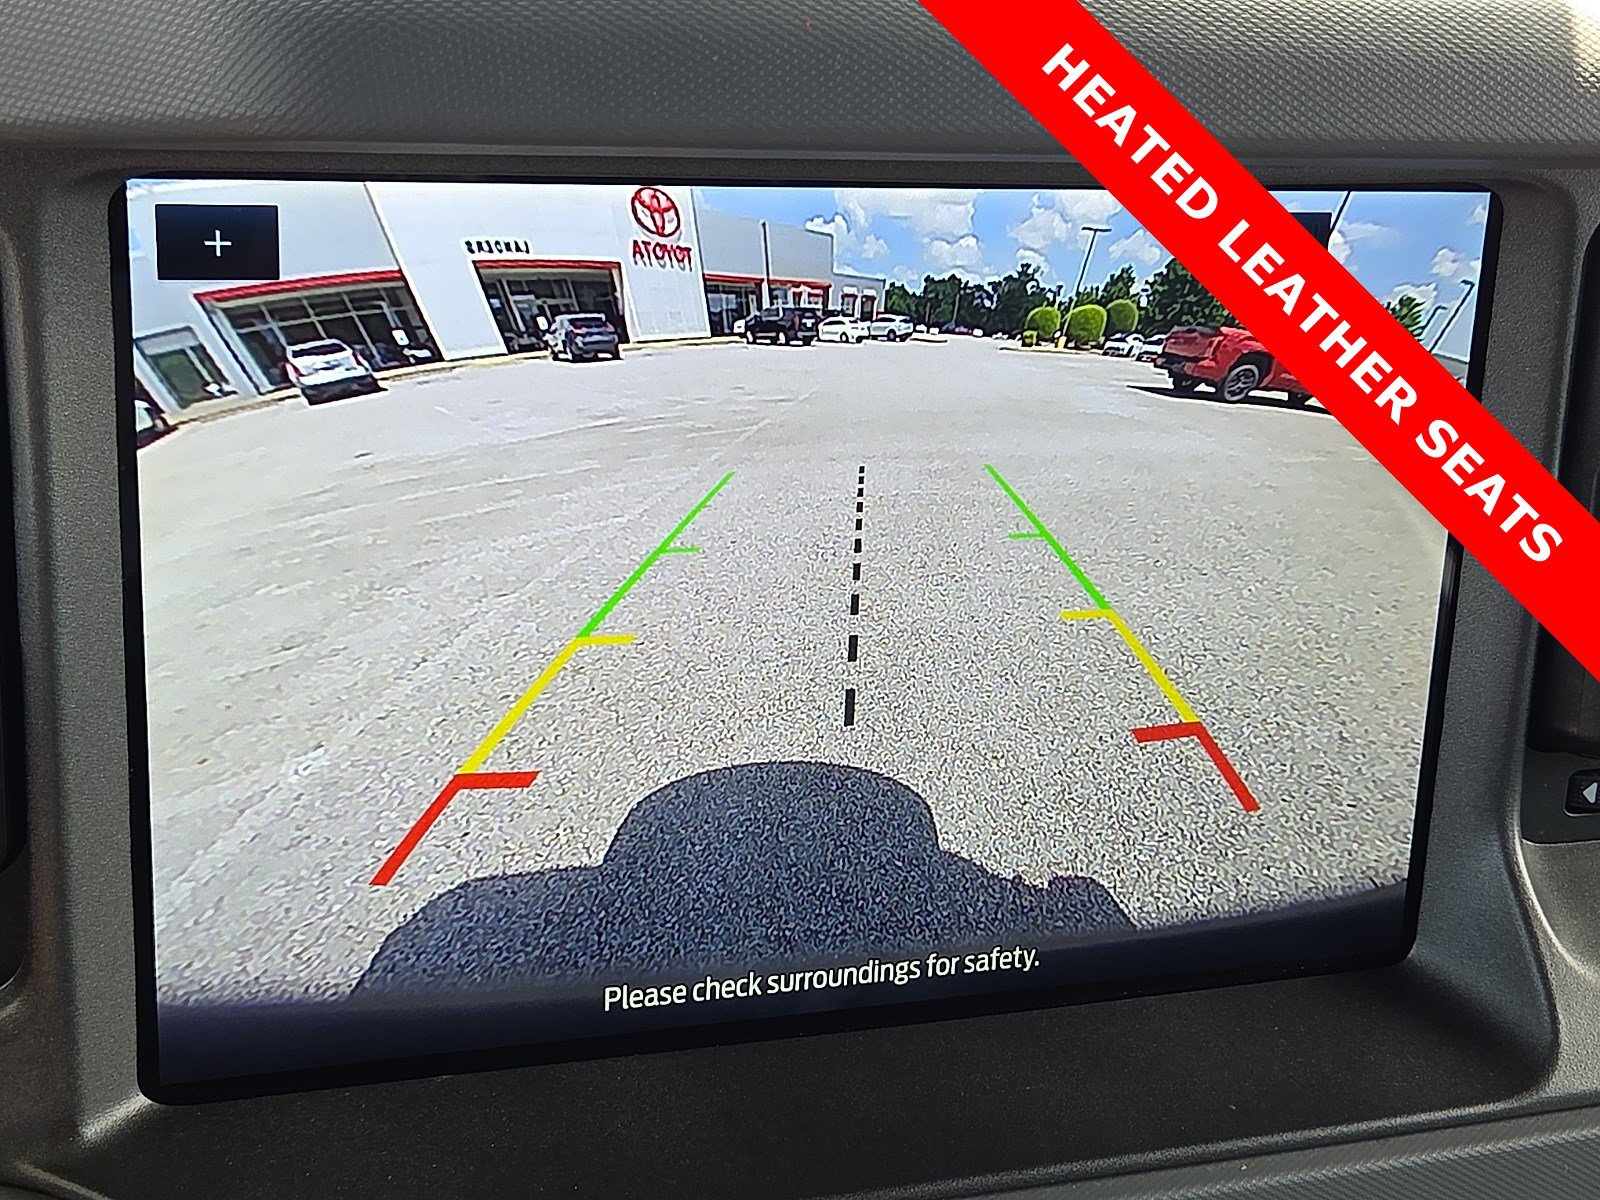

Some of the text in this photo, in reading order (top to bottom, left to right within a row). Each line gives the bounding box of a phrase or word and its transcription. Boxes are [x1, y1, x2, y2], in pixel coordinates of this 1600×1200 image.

[604, 946, 1040, 1012] Please check surroundings for safety.
